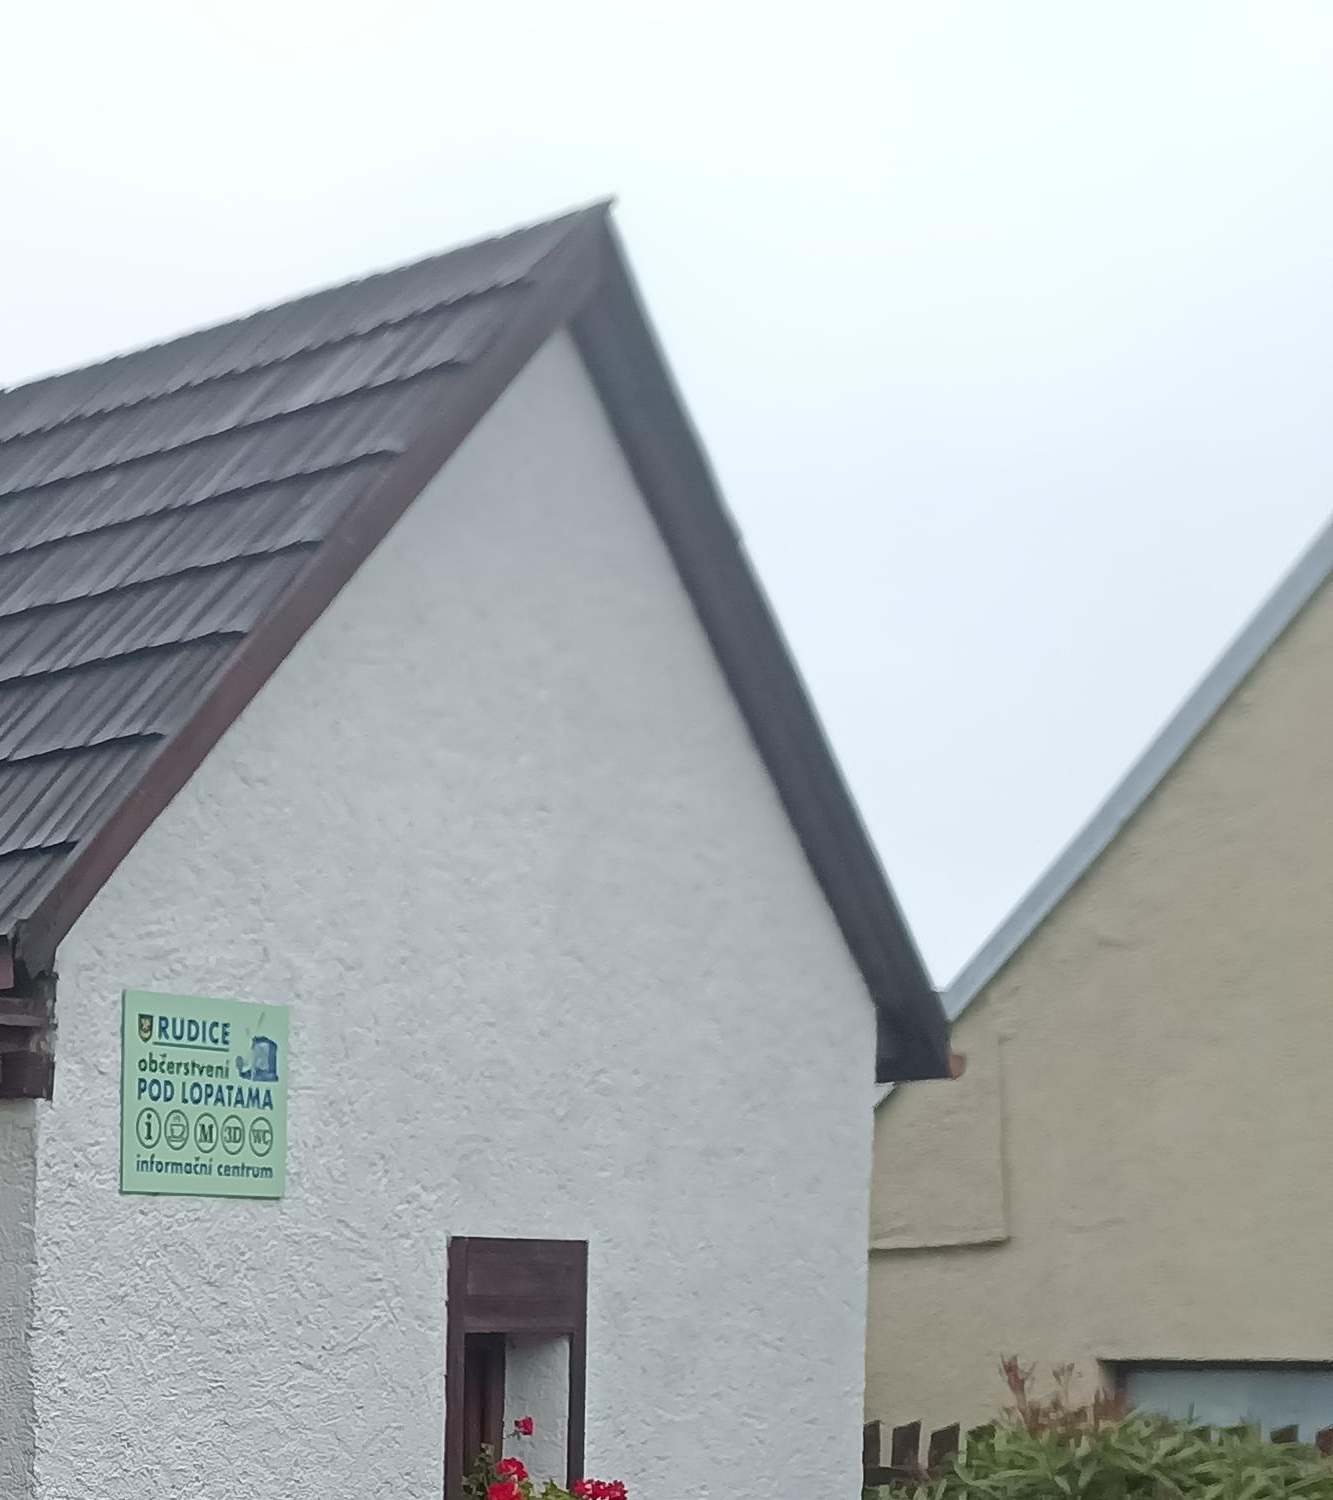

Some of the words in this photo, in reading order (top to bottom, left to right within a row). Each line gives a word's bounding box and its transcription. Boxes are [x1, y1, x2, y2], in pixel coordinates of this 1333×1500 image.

[157, 1015, 231, 1046] RUDICE
[137, 1051, 230, 1079] občerstvení
[137, 1077, 175, 1103] POD
[181, 1081, 274, 1110] LOPATAMA
[199, 1123, 214, 1144] M
[223, 1125, 243, 1144] 3D
[251, 1129, 271, 1146] WC
[136, 1153, 213, 1176] informační
[217, 1162, 274, 1179] centrum
